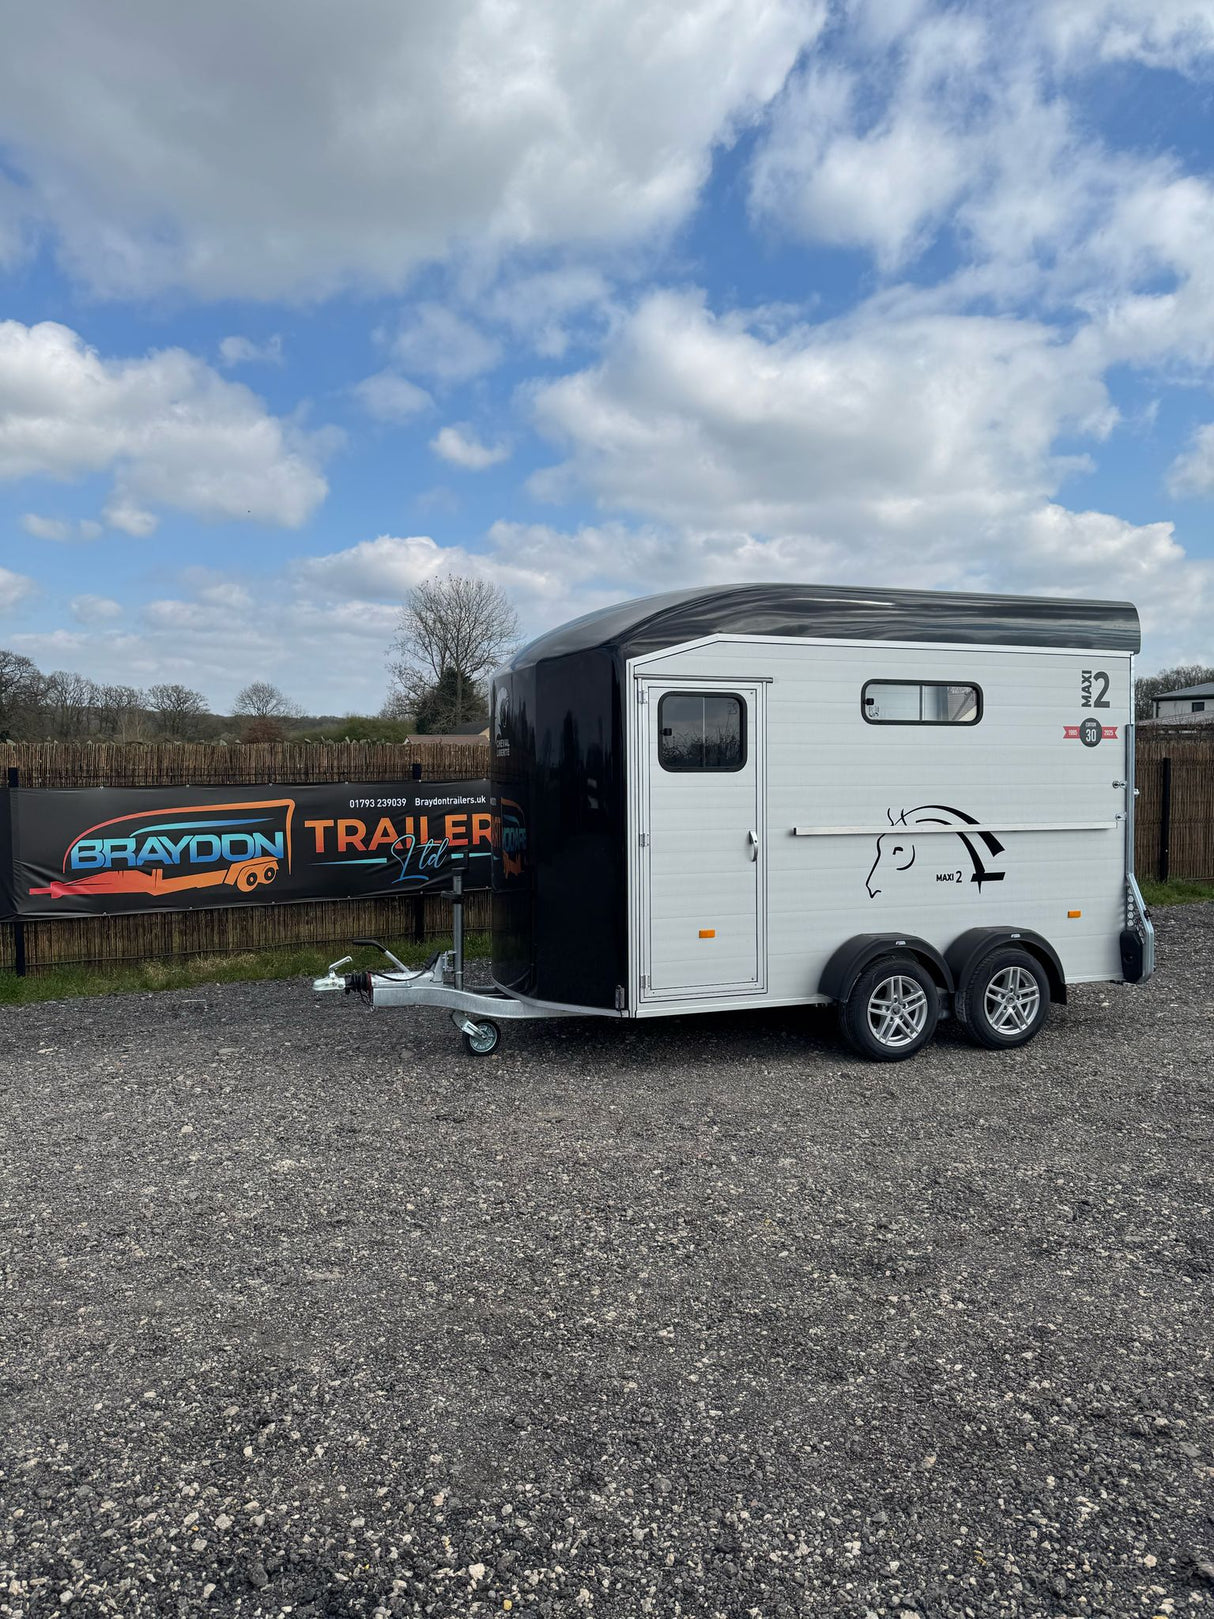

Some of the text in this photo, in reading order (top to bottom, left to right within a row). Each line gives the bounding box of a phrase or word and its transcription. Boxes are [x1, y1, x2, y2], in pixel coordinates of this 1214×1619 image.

[1081, 670, 1110, 708] MAXI 2
[1085, 728, 1097, 742] 30
[349, 795, 487, 809] 01793 239039 Braydontrailers.uk
[70, 831, 284, 870] BRAYDON
[391, 834, 450, 884] Ltd
[936, 871, 963, 883] MAXI 2
